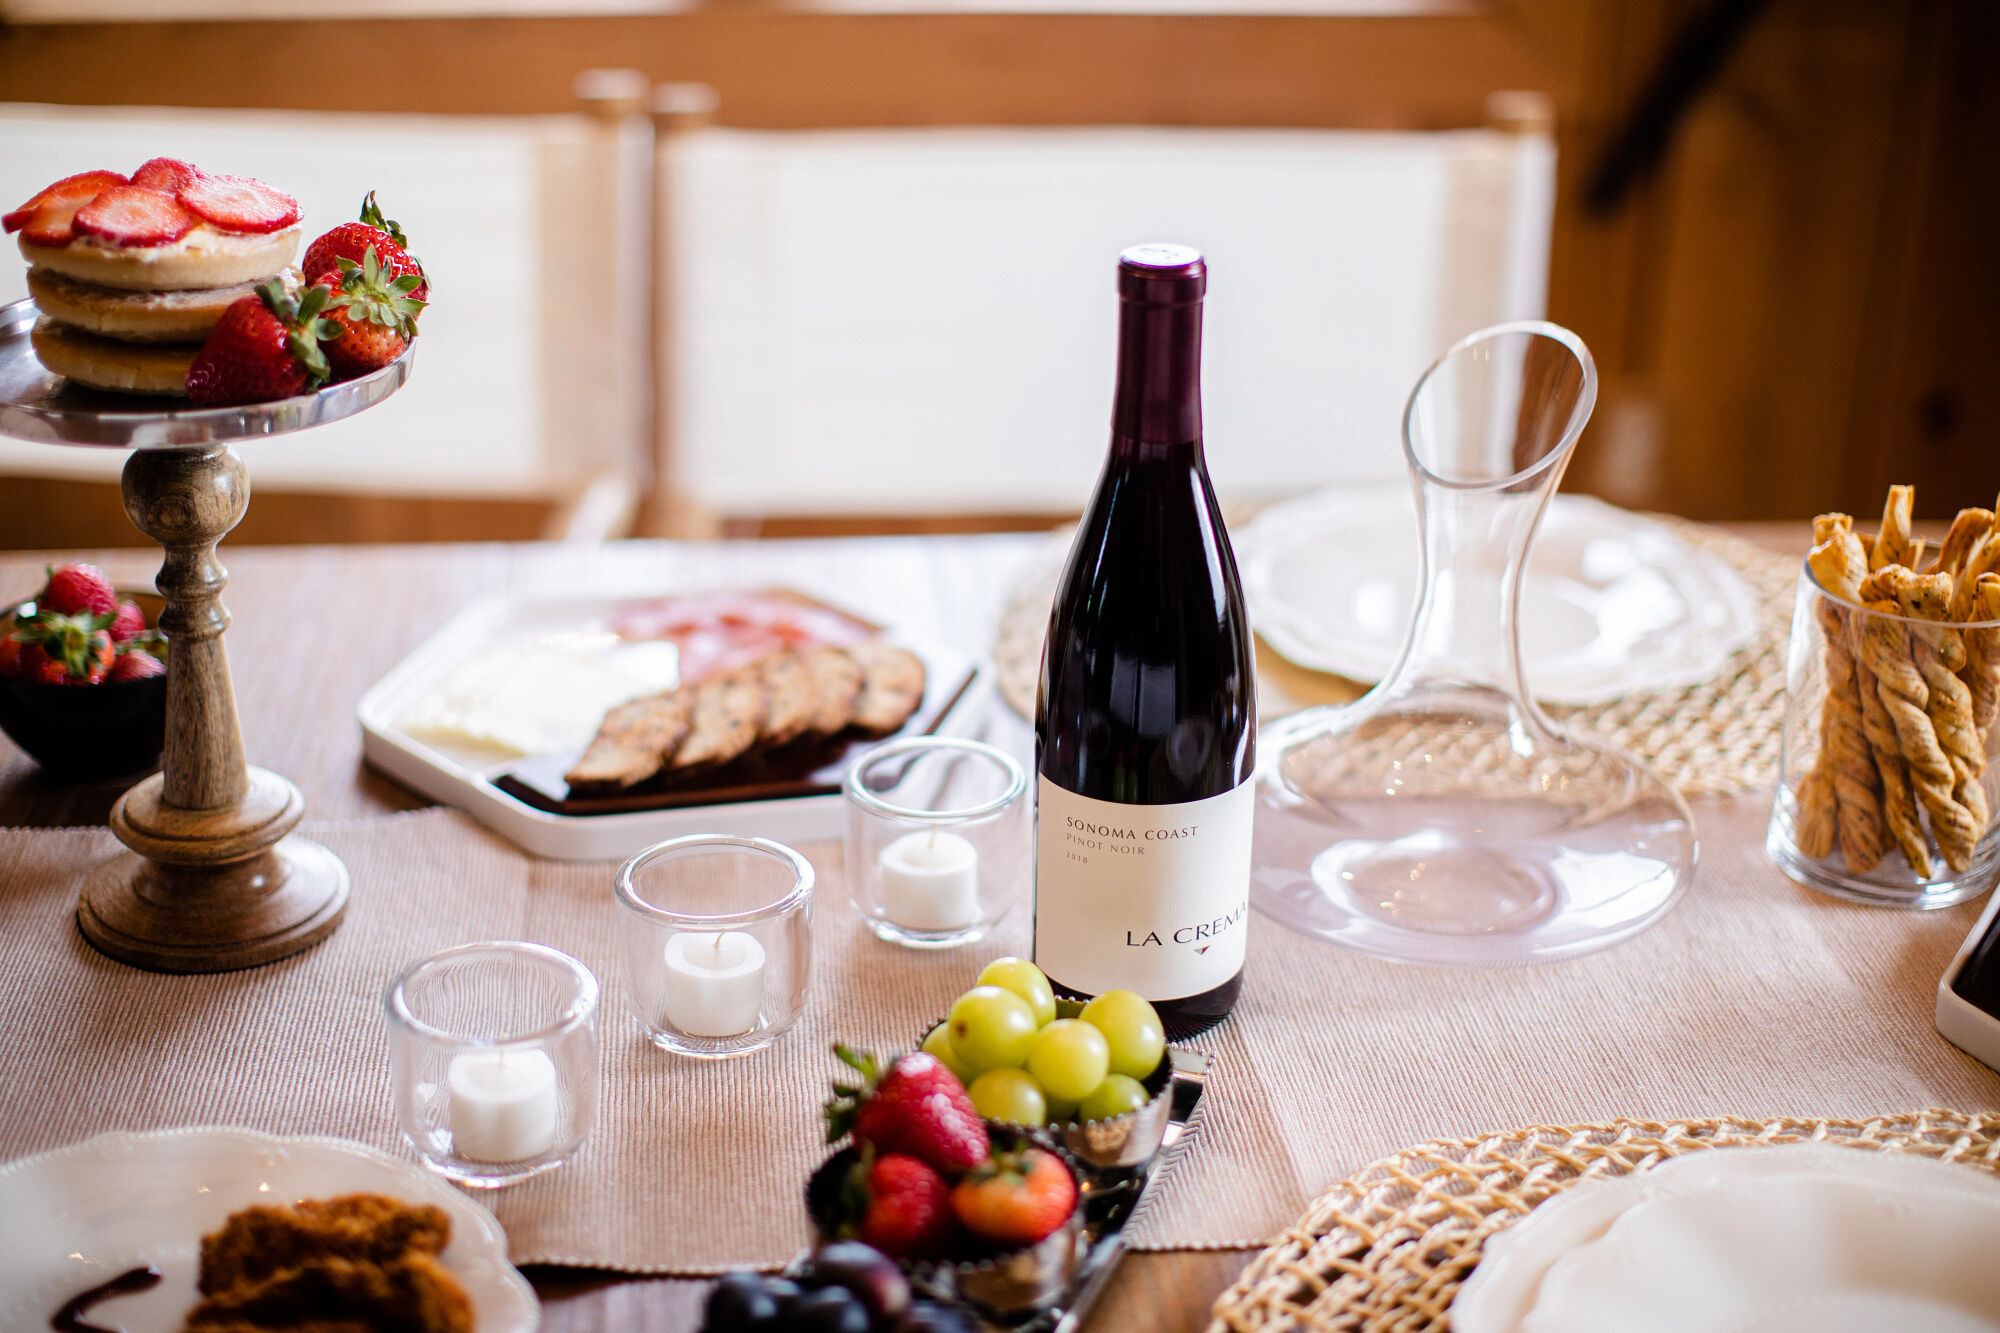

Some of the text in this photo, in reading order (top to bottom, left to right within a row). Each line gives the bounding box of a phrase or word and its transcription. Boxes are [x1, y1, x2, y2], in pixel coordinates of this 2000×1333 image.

[1066, 816, 1199, 841] SONOMA COAST
[1066, 832, 1146, 856] PINOT NOIR
[1065, 851, 1089, 864] 2018
[1126, 900, 1246, 947] LA CREMA
